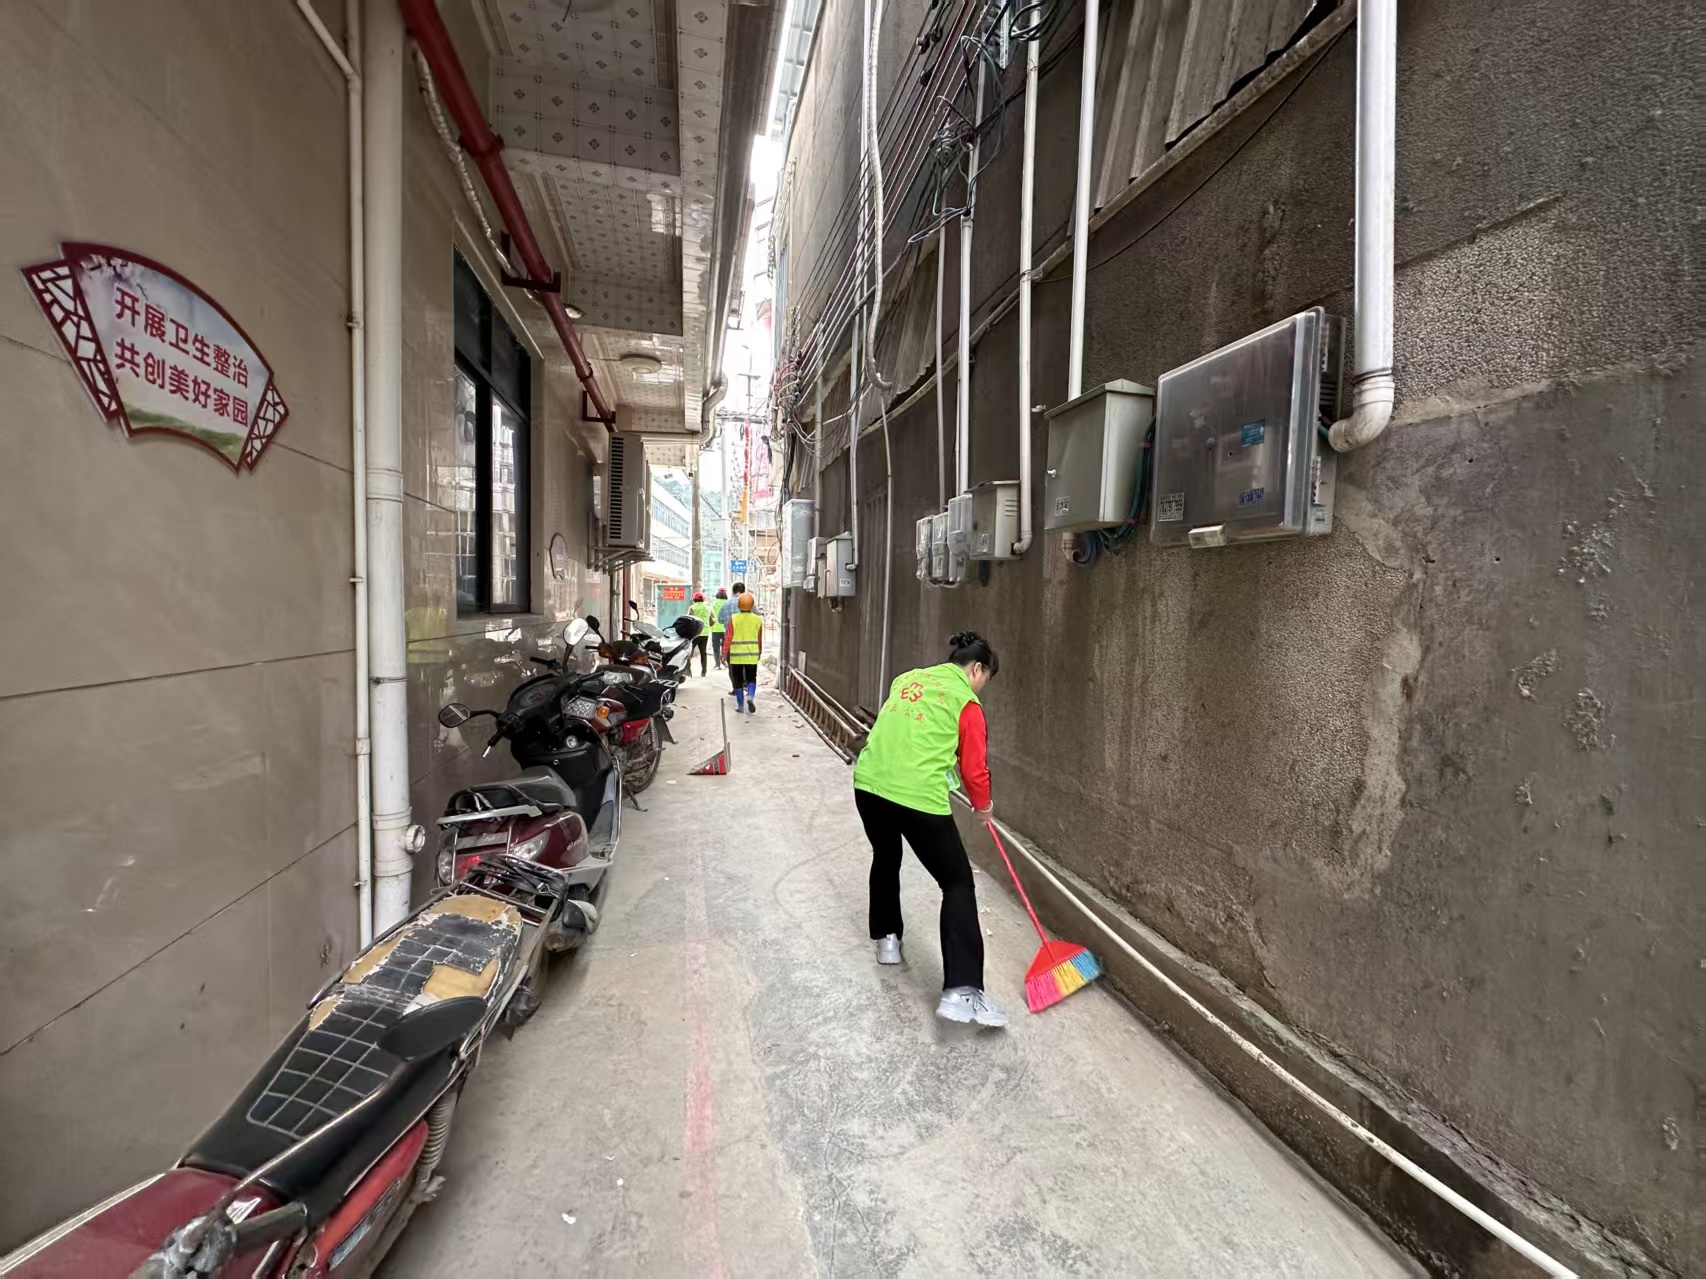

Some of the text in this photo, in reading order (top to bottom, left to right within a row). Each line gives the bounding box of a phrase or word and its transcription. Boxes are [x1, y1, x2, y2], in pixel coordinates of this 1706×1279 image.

[115, 286, 249, 389] 开展卫生整治
[115, 338, 249, 427] 共创美好家园
